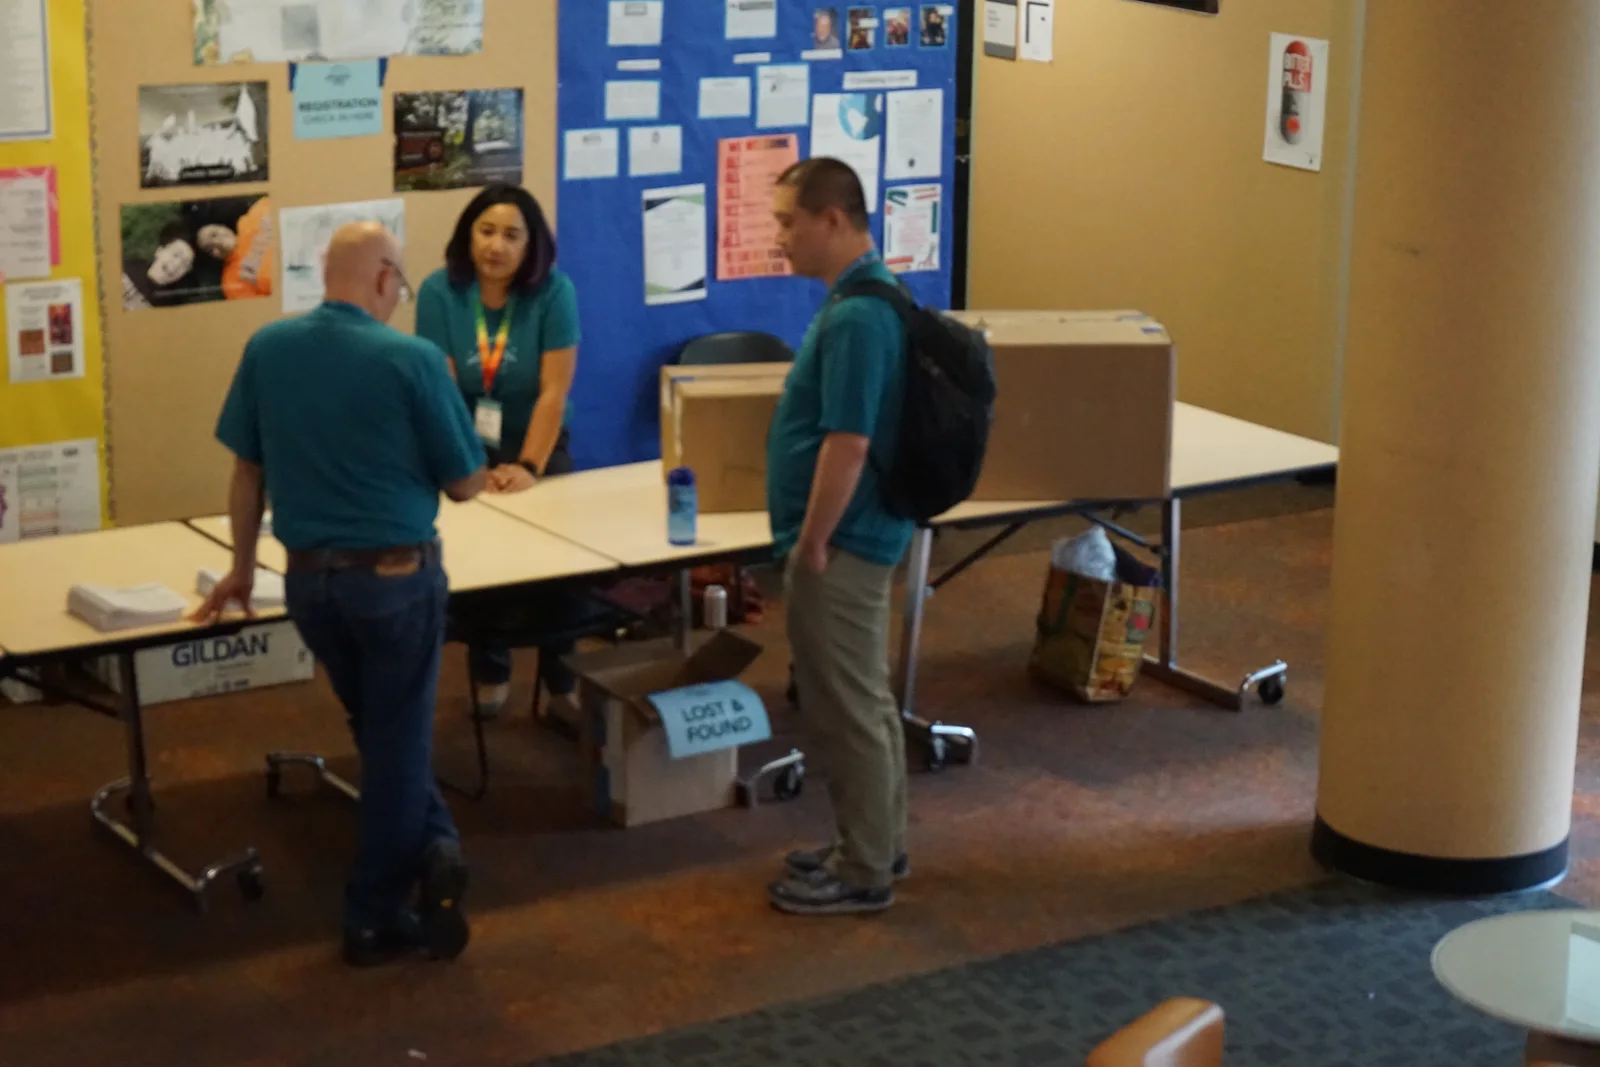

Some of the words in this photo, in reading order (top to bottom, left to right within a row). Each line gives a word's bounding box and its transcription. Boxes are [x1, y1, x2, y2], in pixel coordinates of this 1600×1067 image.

[299, 98, 378, 112] REGISTRATION
[172, 634, 269, 668] GILDAN
[682, 701, 725, 723] LOST
[730, 699, 745, 712] &
[687, 716, 753, 743] FOUND
